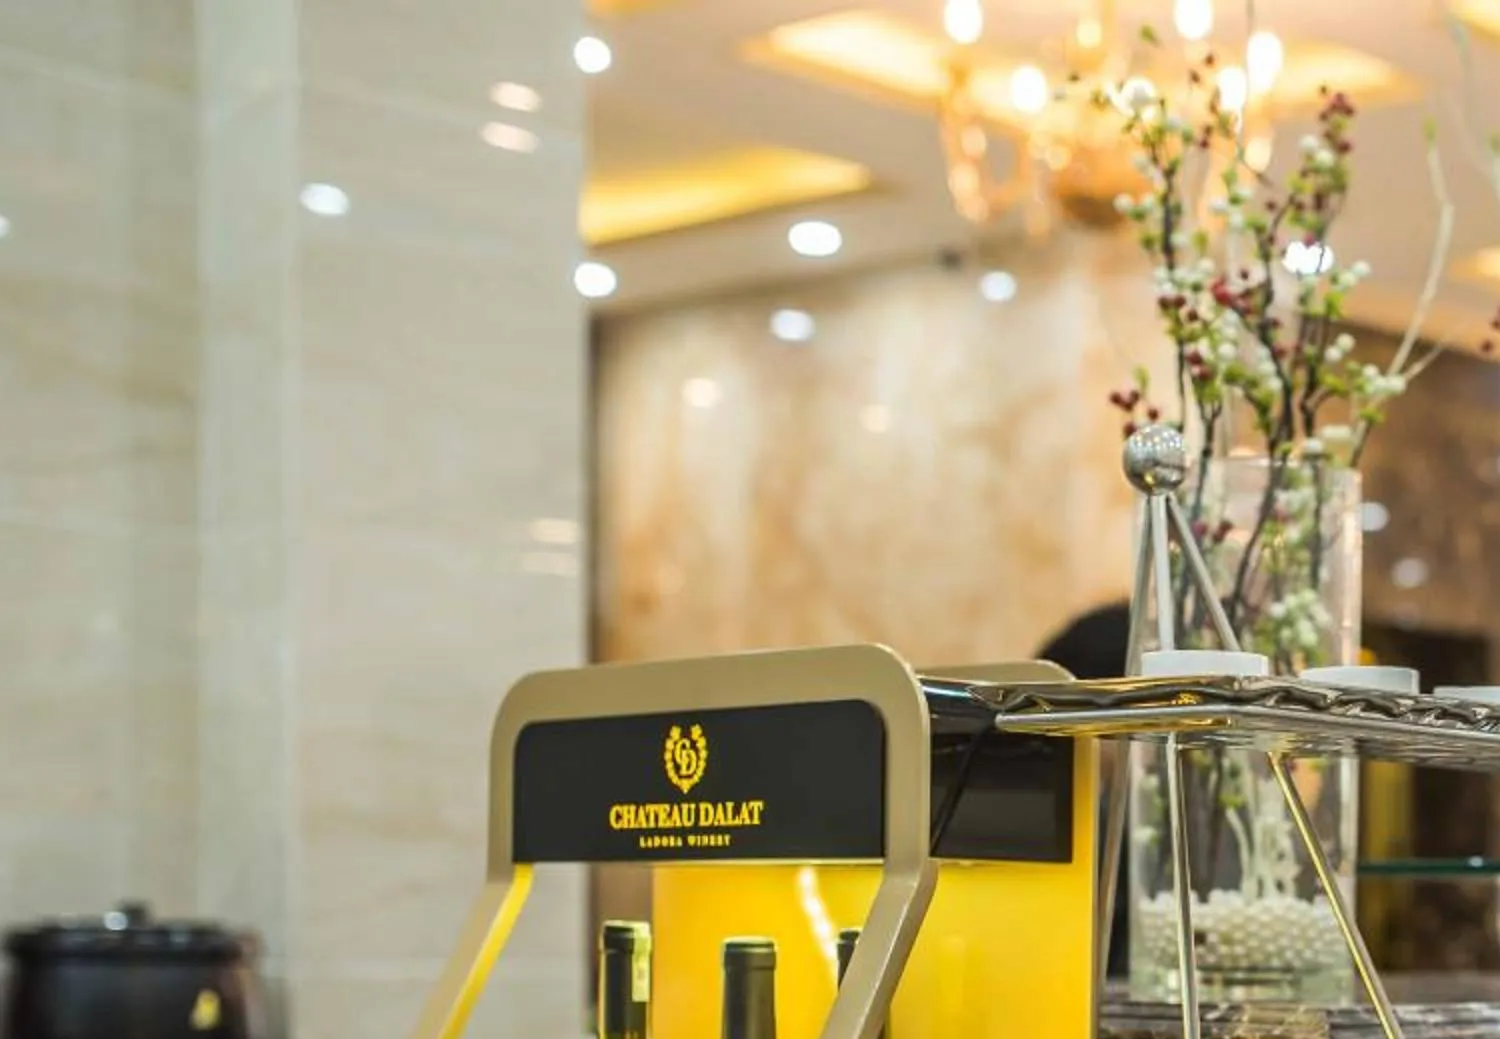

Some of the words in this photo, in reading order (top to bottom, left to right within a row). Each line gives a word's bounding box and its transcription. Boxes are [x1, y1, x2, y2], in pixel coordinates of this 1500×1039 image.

[609, 803, 696, 830] CHATEAU
[699, 800, 764, 828] DALAT
[687, 834, 731, 847] WINERY
